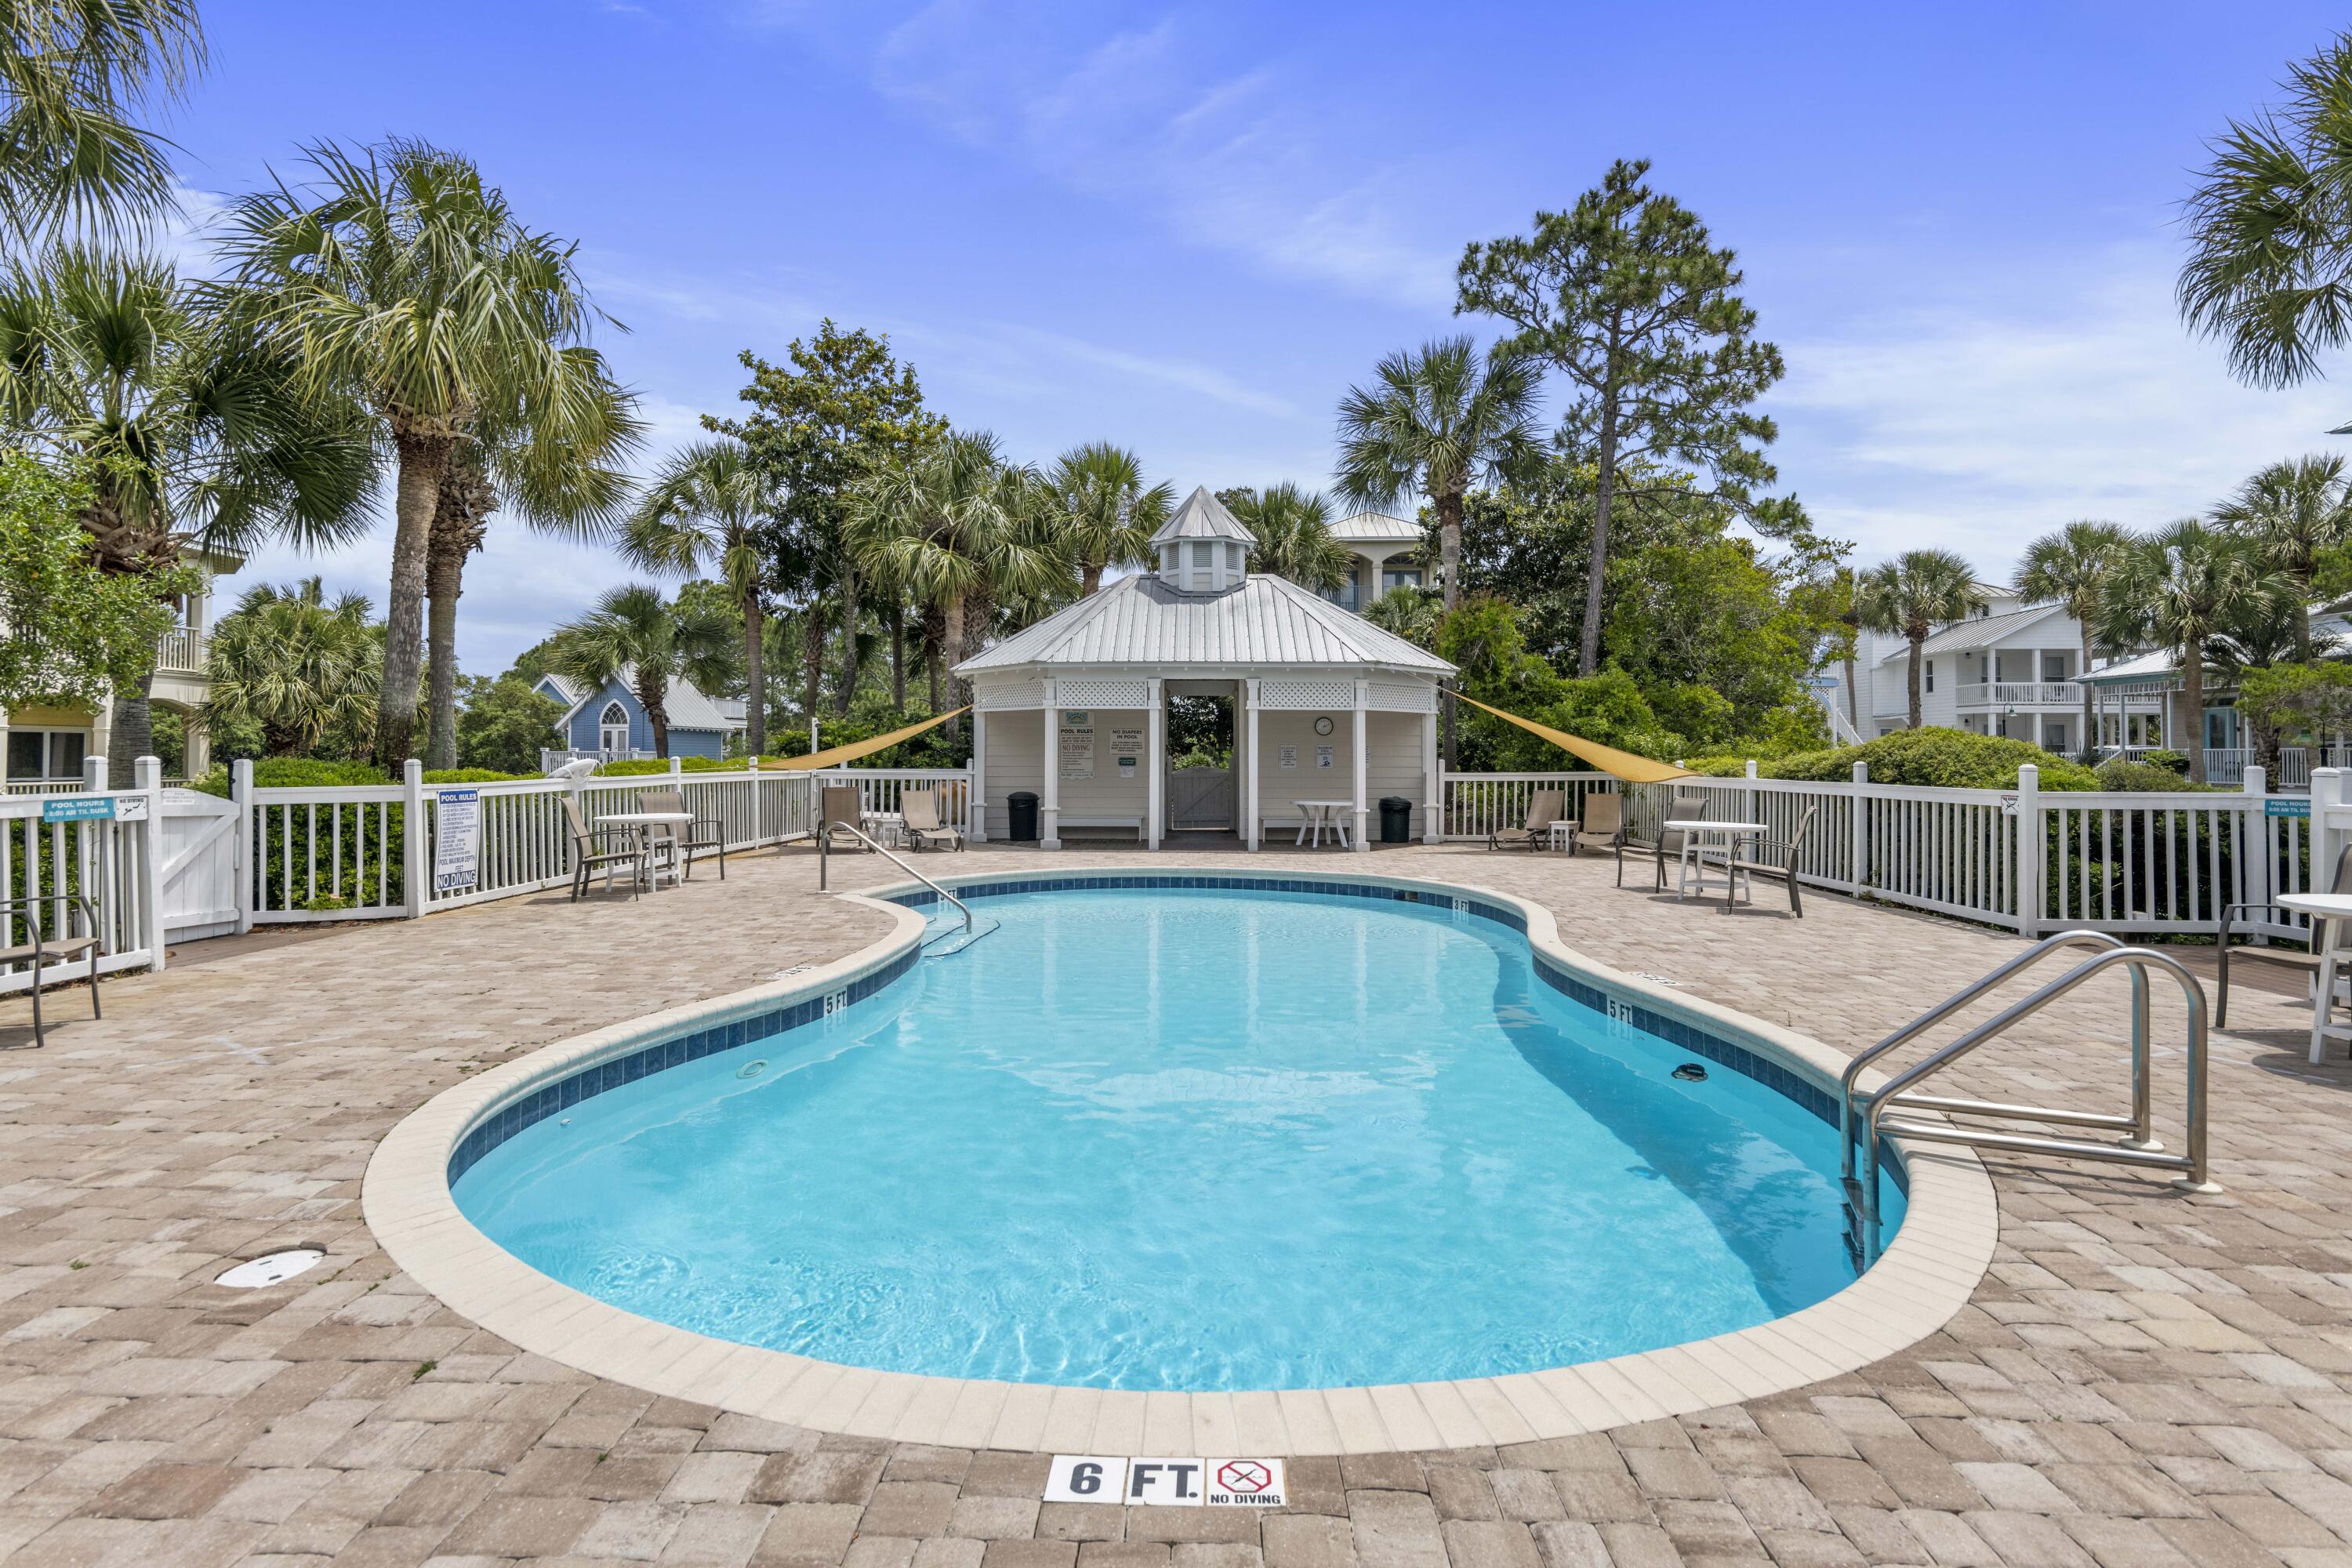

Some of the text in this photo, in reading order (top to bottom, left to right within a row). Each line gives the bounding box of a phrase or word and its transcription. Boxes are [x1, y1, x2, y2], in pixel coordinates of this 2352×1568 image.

[438, 871, 476, 888] NO DIVING
[1454, 899, 1459, 910] 3
[827, 996, 833, 1014] 5
[1610, 1000, 1616, 1018] 5
[1069, 1462, 1198, 1498] 6 FT.
[1210, 1494, 1281, 1504] NO DIVING
